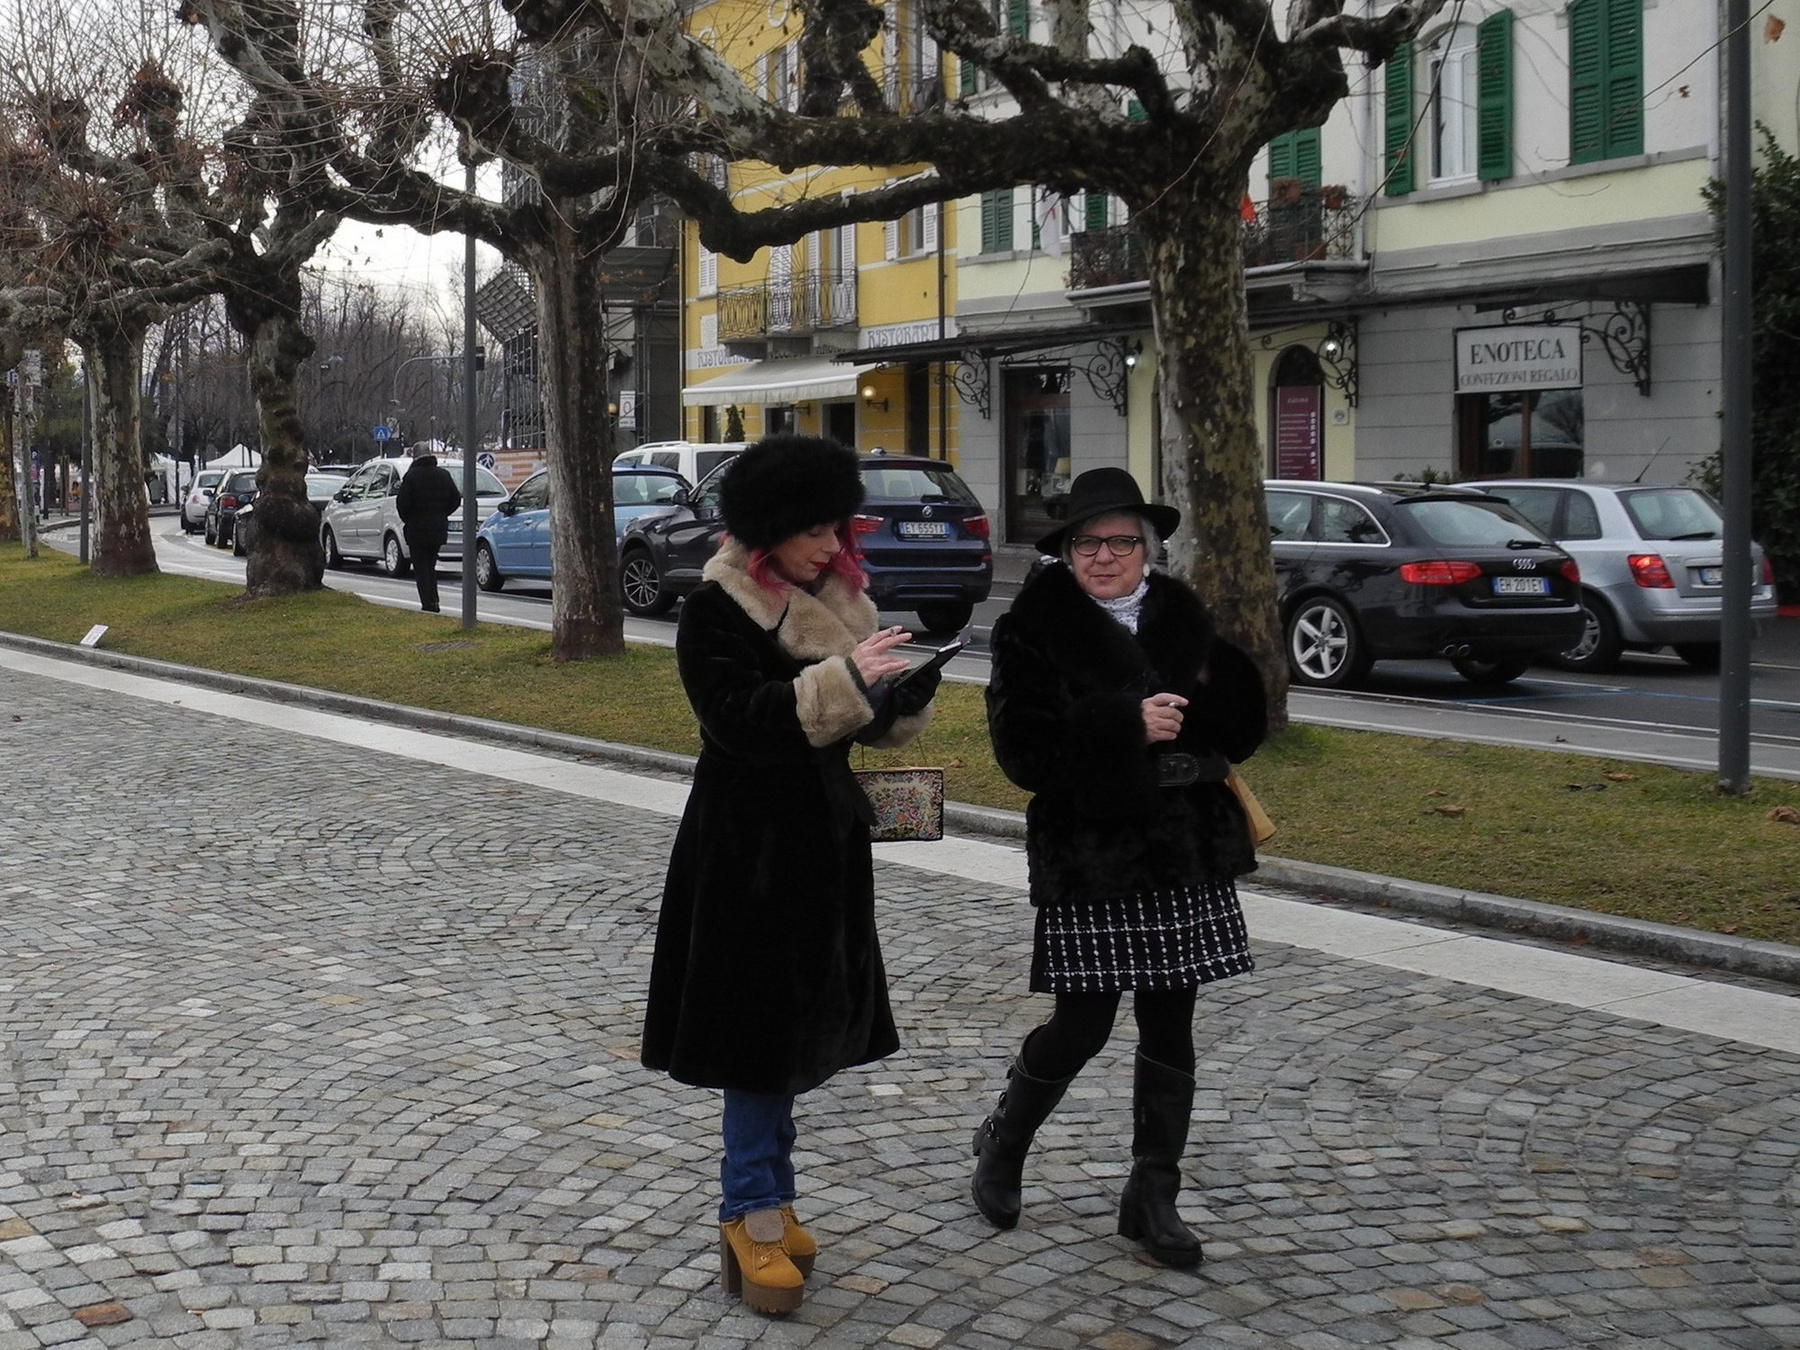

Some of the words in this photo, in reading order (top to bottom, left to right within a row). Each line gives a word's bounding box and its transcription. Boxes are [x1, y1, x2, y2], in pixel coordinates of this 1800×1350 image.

[1470, 338, 1565, 365] ENOTECA
[1460, 370, 1527, 386] CONFEZIONI
[1529, 368, 1578, 384] REGALO
